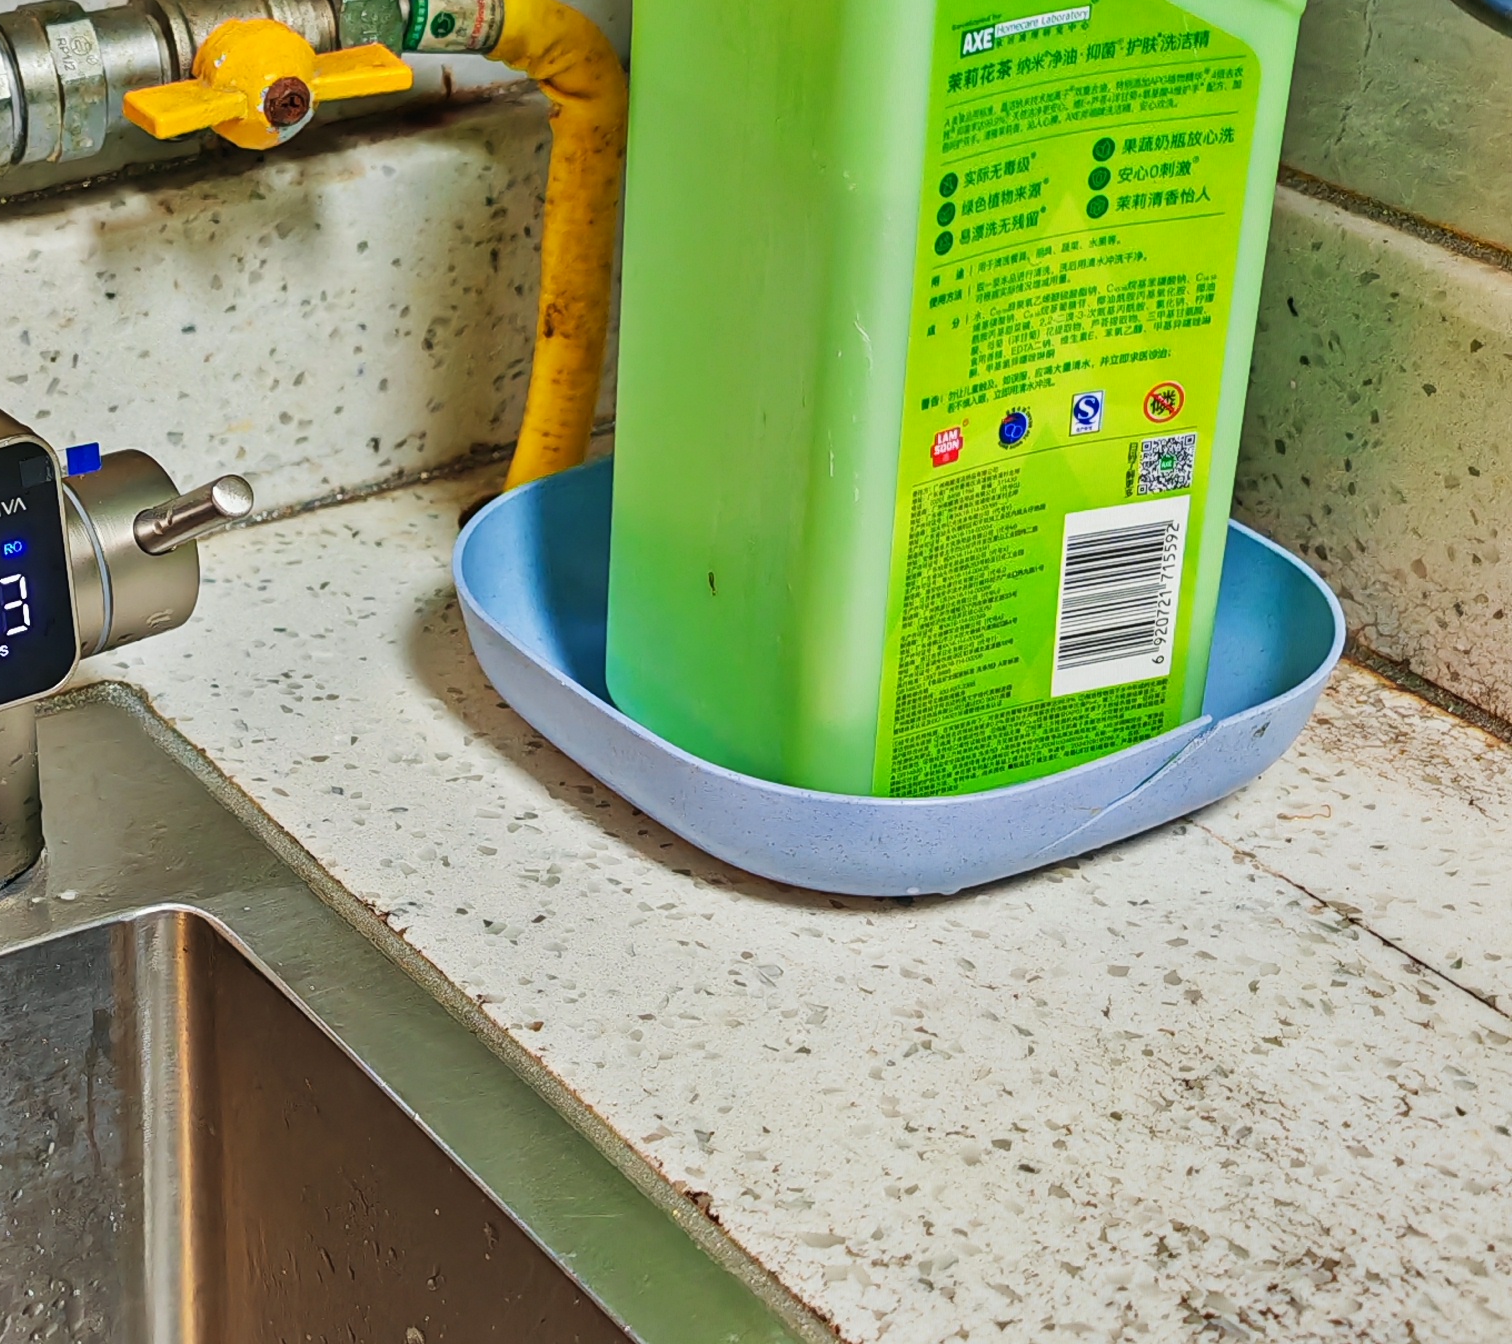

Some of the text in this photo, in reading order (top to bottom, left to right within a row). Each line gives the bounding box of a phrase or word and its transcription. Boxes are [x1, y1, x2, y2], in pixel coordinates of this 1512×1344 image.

[962, 26, 995, 56] AXE
[996, 18, 1039, 37] Homecare
[1041, 9, 1089, 26] Laboratory
[946, 58, 1013, 94] 茉莉花茶
[1121, 126, 1235, 155] 果蔬奶瓶放心洗
[1114, 185, 1212, 213] 茉莉清香怡人
[933, 439, 960, 456] SOON
[937, 428, 959, 444] LAM
[2, 540, 23, 556] RO
[1159, 522, 1180, 584] 715592
[1153, 589, 1173, 646] 920721
